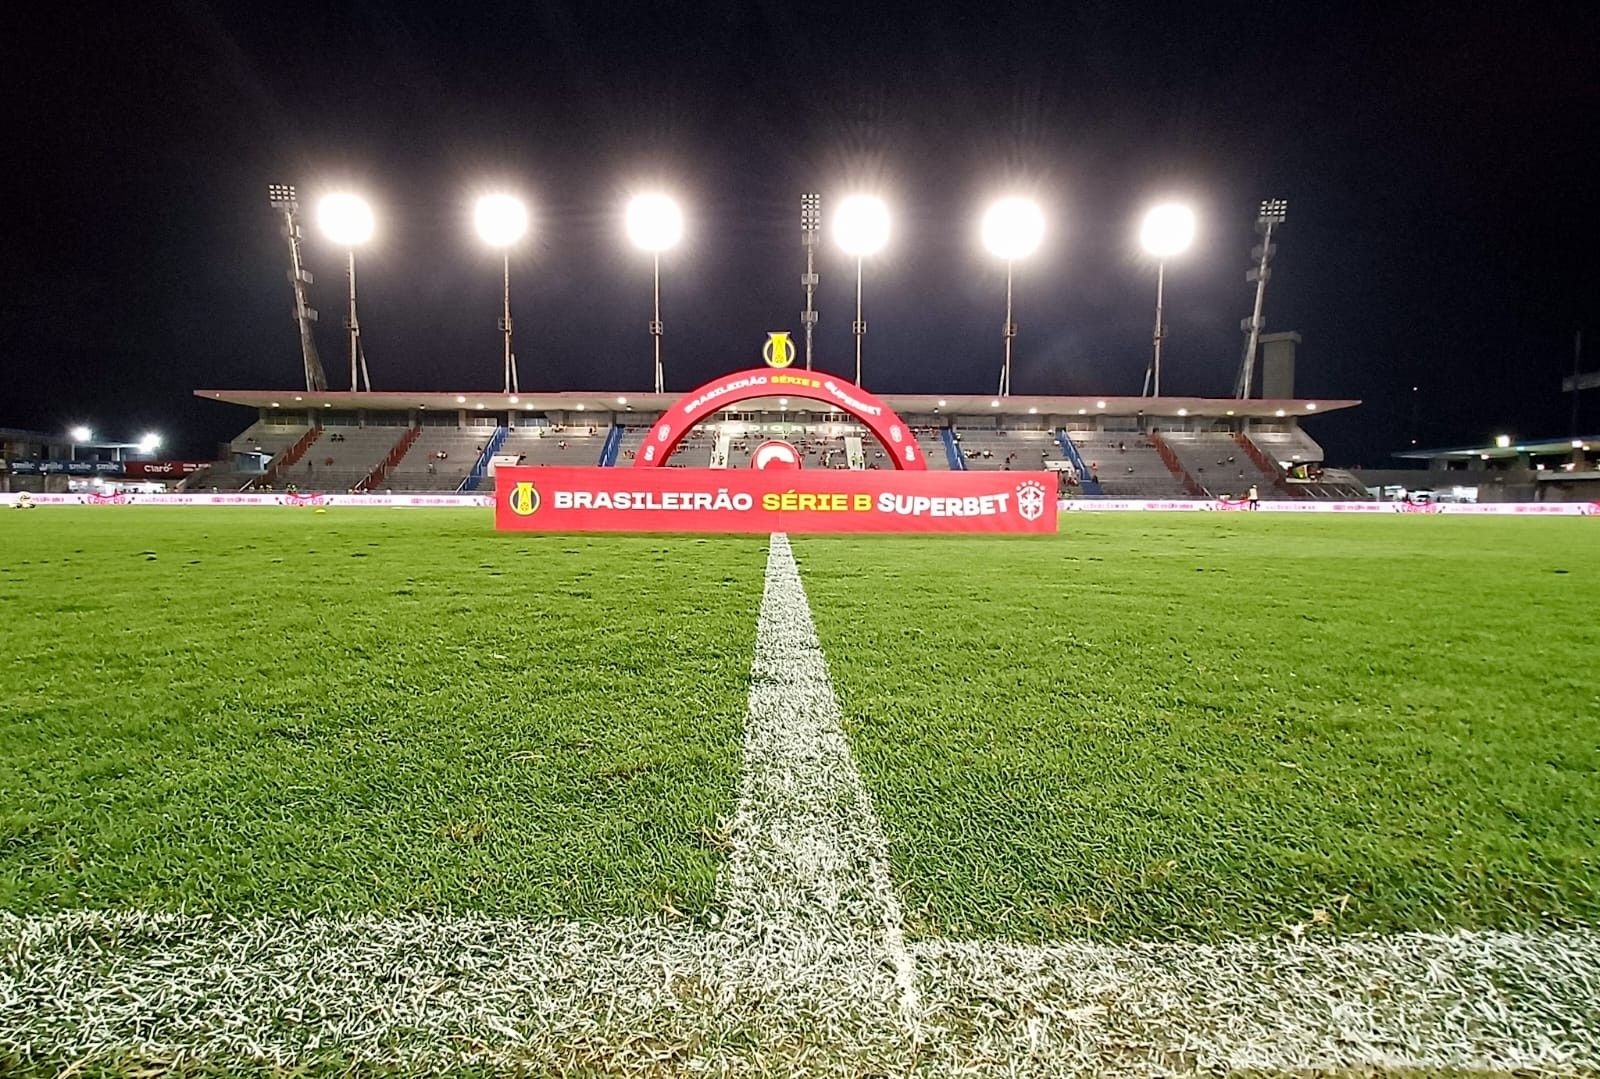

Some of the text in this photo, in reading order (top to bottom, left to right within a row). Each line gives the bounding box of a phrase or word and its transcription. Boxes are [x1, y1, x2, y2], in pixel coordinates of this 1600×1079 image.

[683, 376, 768, 414] BRASILEIRÃO
[770, 375, 810, 387] SÉRIE
[824, 381, 882, 417] SUPERBET
[143, 463, 171, 473] Claro
[553, 488, 1010, 517] BRASILEIRÃO SÉRIE B SUPERBET
